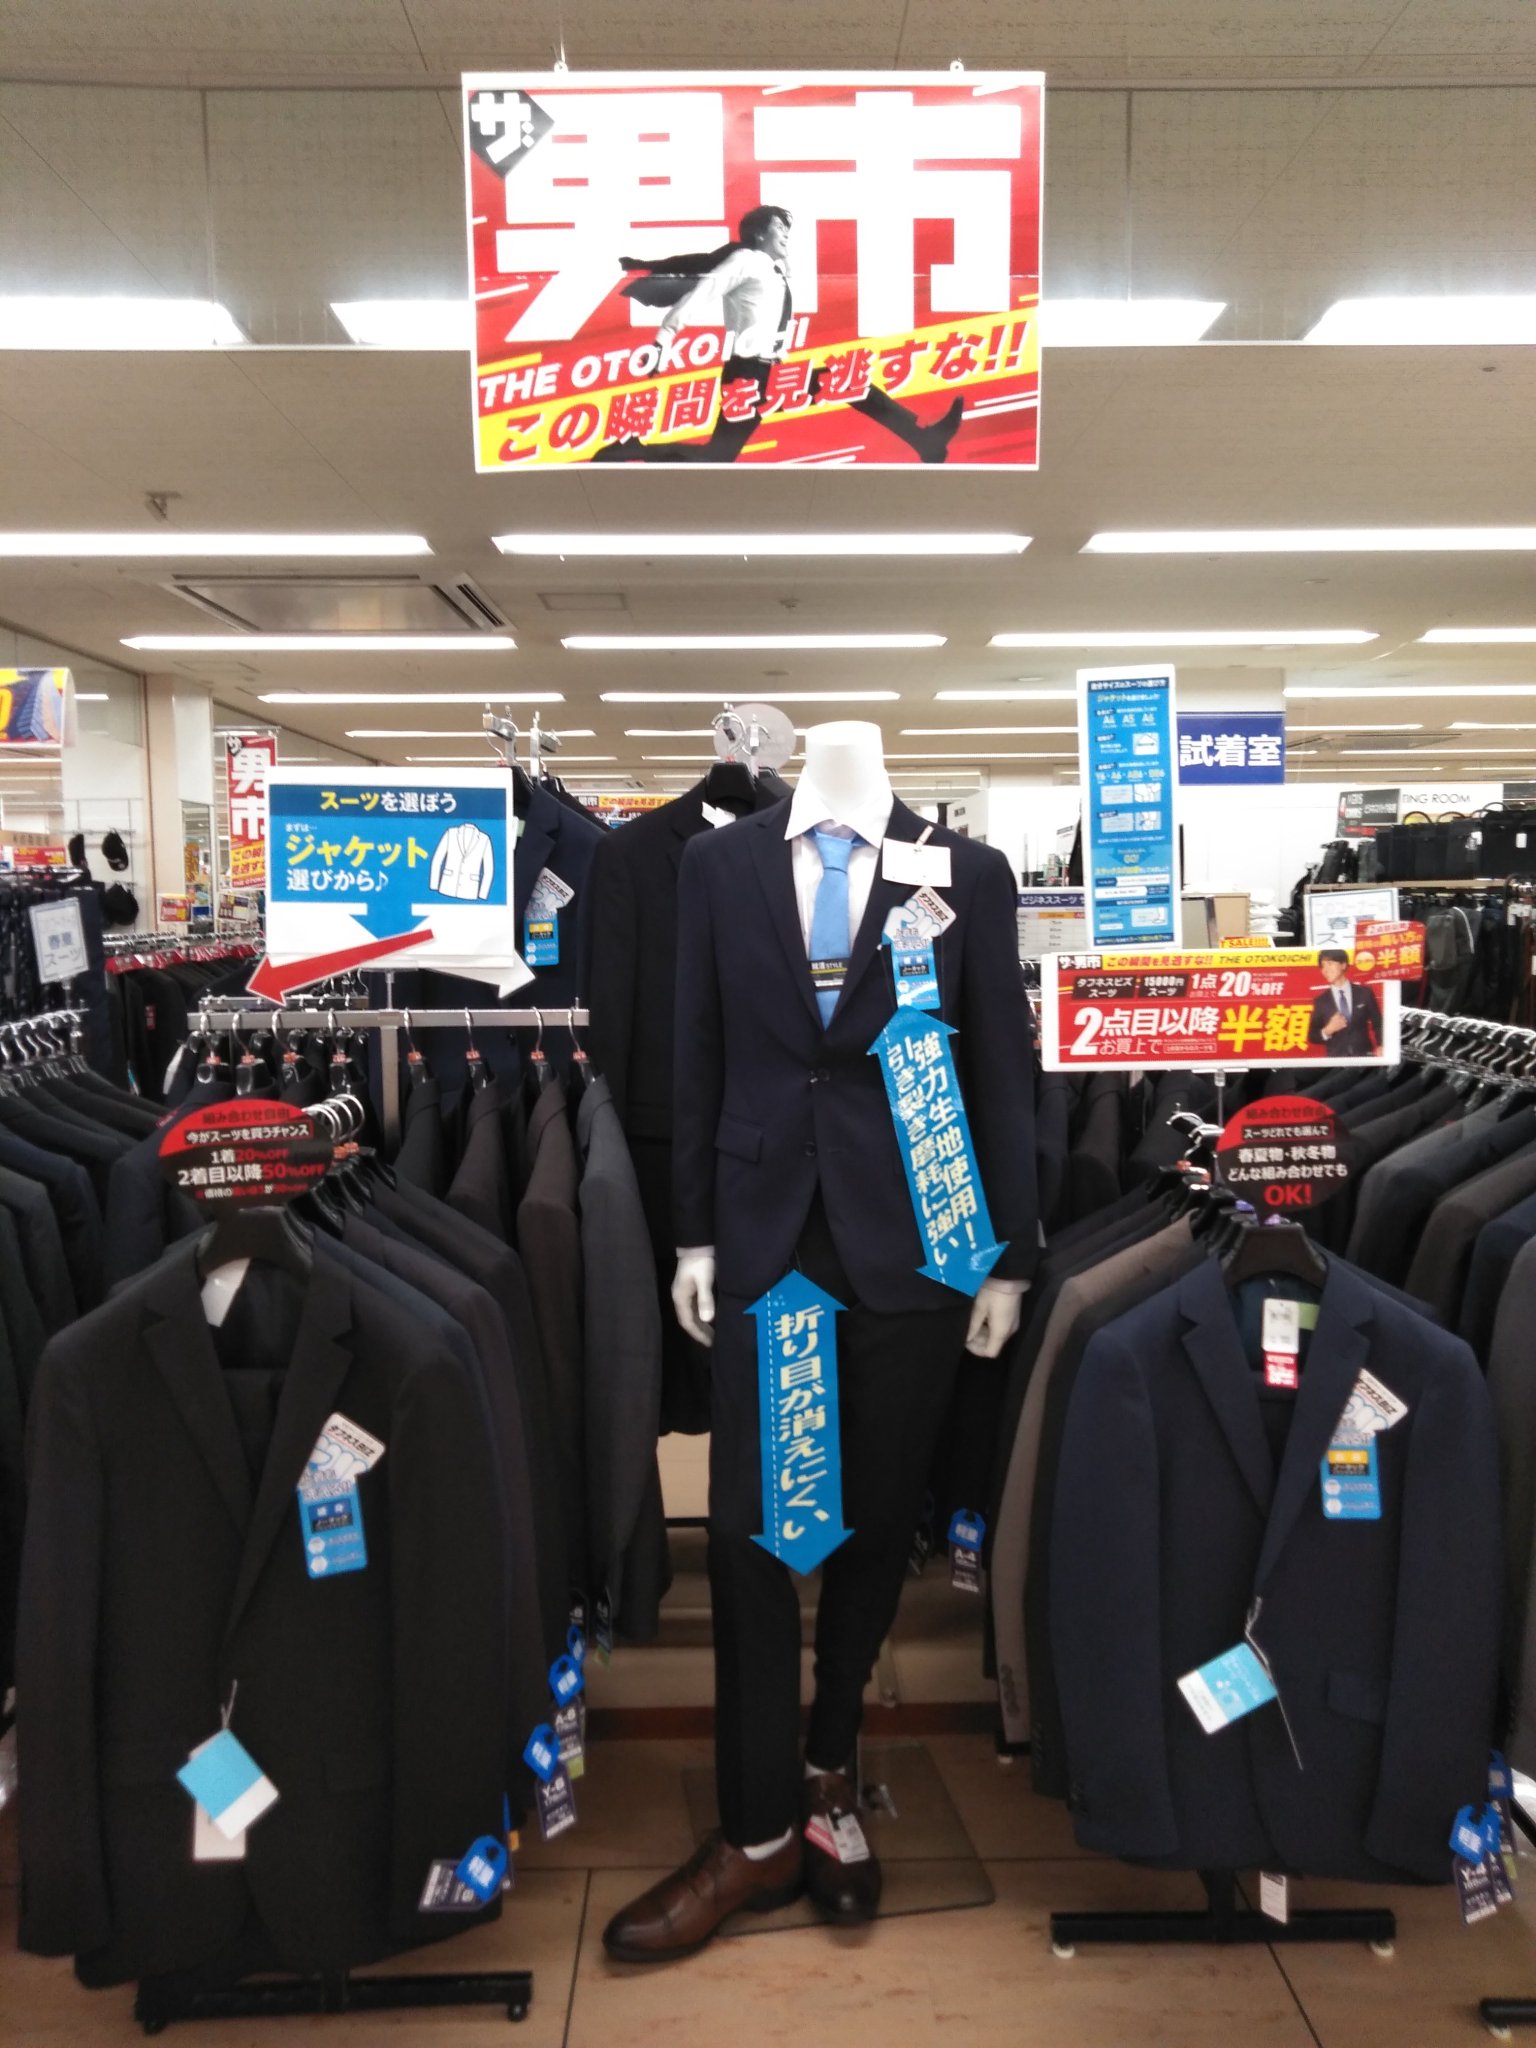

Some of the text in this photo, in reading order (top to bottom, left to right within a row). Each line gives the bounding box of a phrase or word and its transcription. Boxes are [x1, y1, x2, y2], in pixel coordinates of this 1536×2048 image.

[478, 367, 559, 411] THE
[498, 319, 1029, 463] この瞬間を見逃すな!!
[1179, 734, 1283, 769] 試着室
[319, 791, 458, 814] スーツを選ぼう
[1432, 793, 1471, 804] ROOM
[285, 834, 429, 868] ジャケット
[1219, 953, 1313, 964] THE OTOKOICHI
[1376, 944, 1422, 969] 半額
[1077, 976, 1132, 988] タフネスビズ
[1148, 988, 1177, 997] スーツ
[1191, 973, 1218, 989] 1点
[1218, 971, 1285, 998] 20%OFF
[1088, 989, 1118, 998] スーツ
[1070, 1006, 1220, 1056] 2点目以降
[1218, 1004, 1315, 1053] 半額
[1100, 1039, 1162, 1055] お買上で
[186, 1124, 309, 1144] 今がスーツを買うチャンス
[912, 1031, 978, 1250] 強力生地使用!
[1227, 1163, 1348, 1182] どんな組み合わせでも
[1264, 1184, 1312, 1206] OK!
[774, 1304, 830, 1541] 折り目が消えにくい
